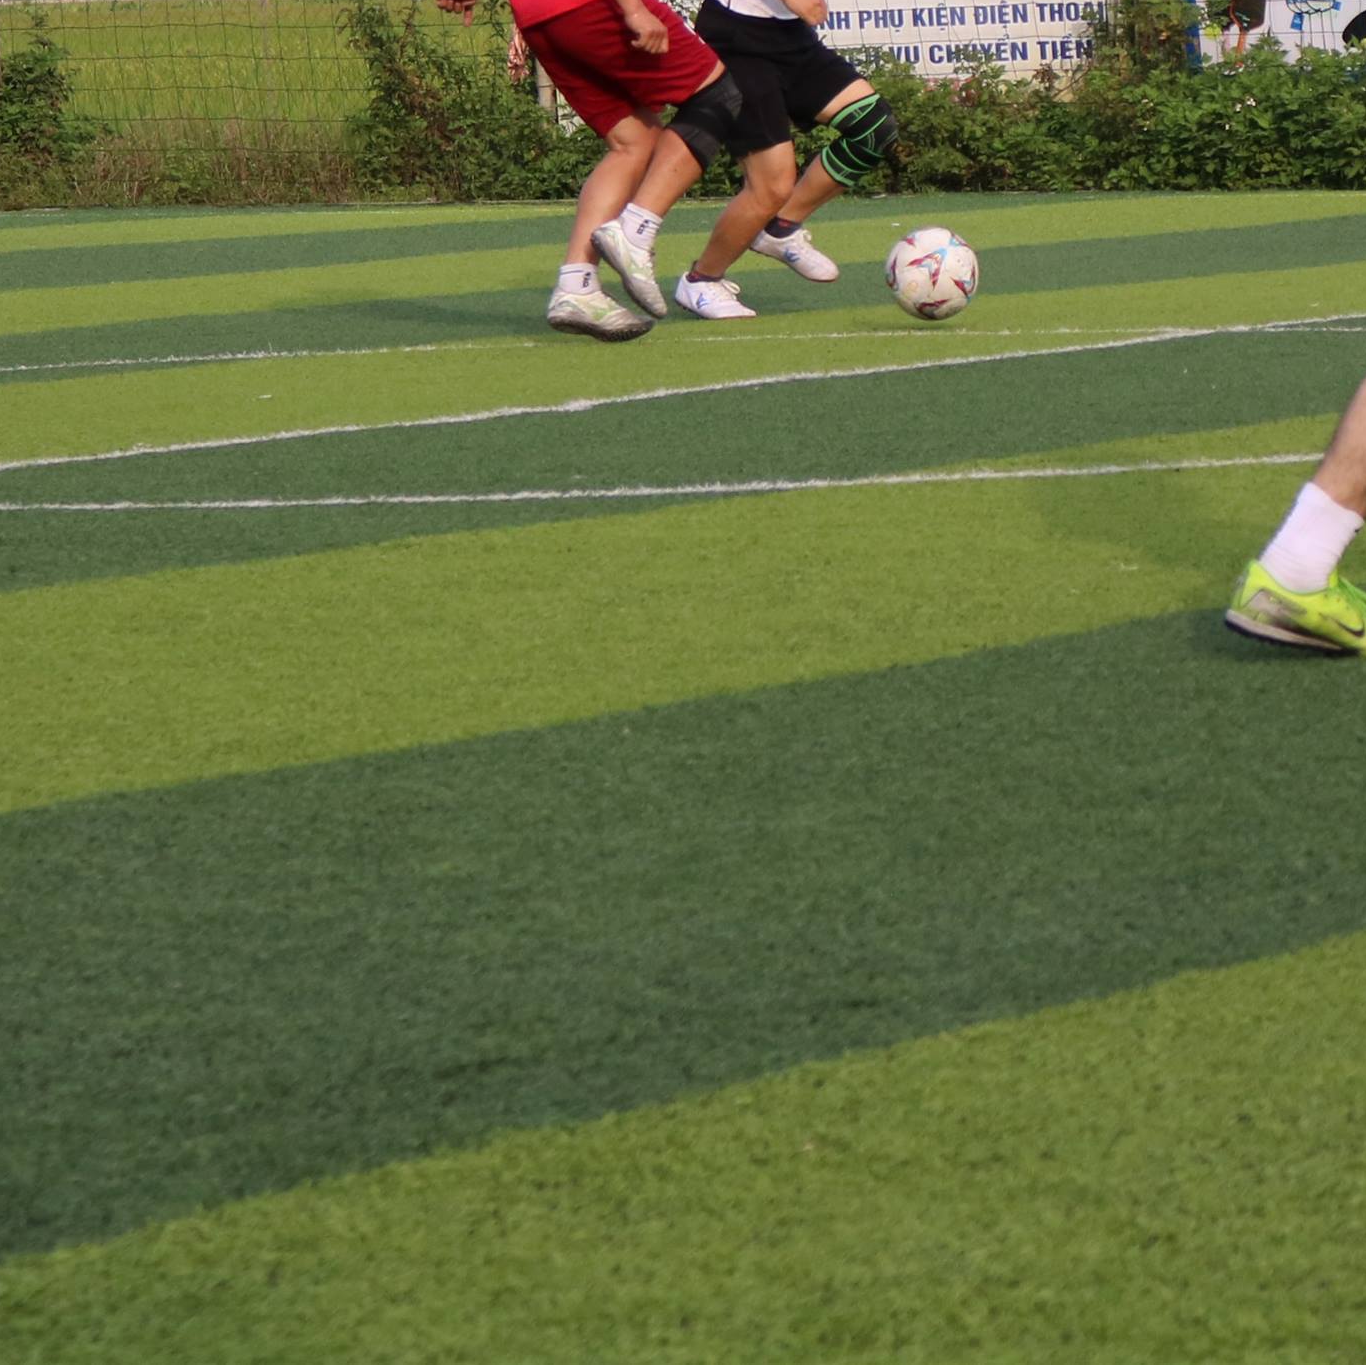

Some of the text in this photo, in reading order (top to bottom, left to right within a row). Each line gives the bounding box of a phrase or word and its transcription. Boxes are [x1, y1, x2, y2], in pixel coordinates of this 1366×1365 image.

[858, 9, 904, 33] PHỤ
[912, 2, 966, 31] KIỆN
[973, 0, 1029, 28] ĐIỆN
